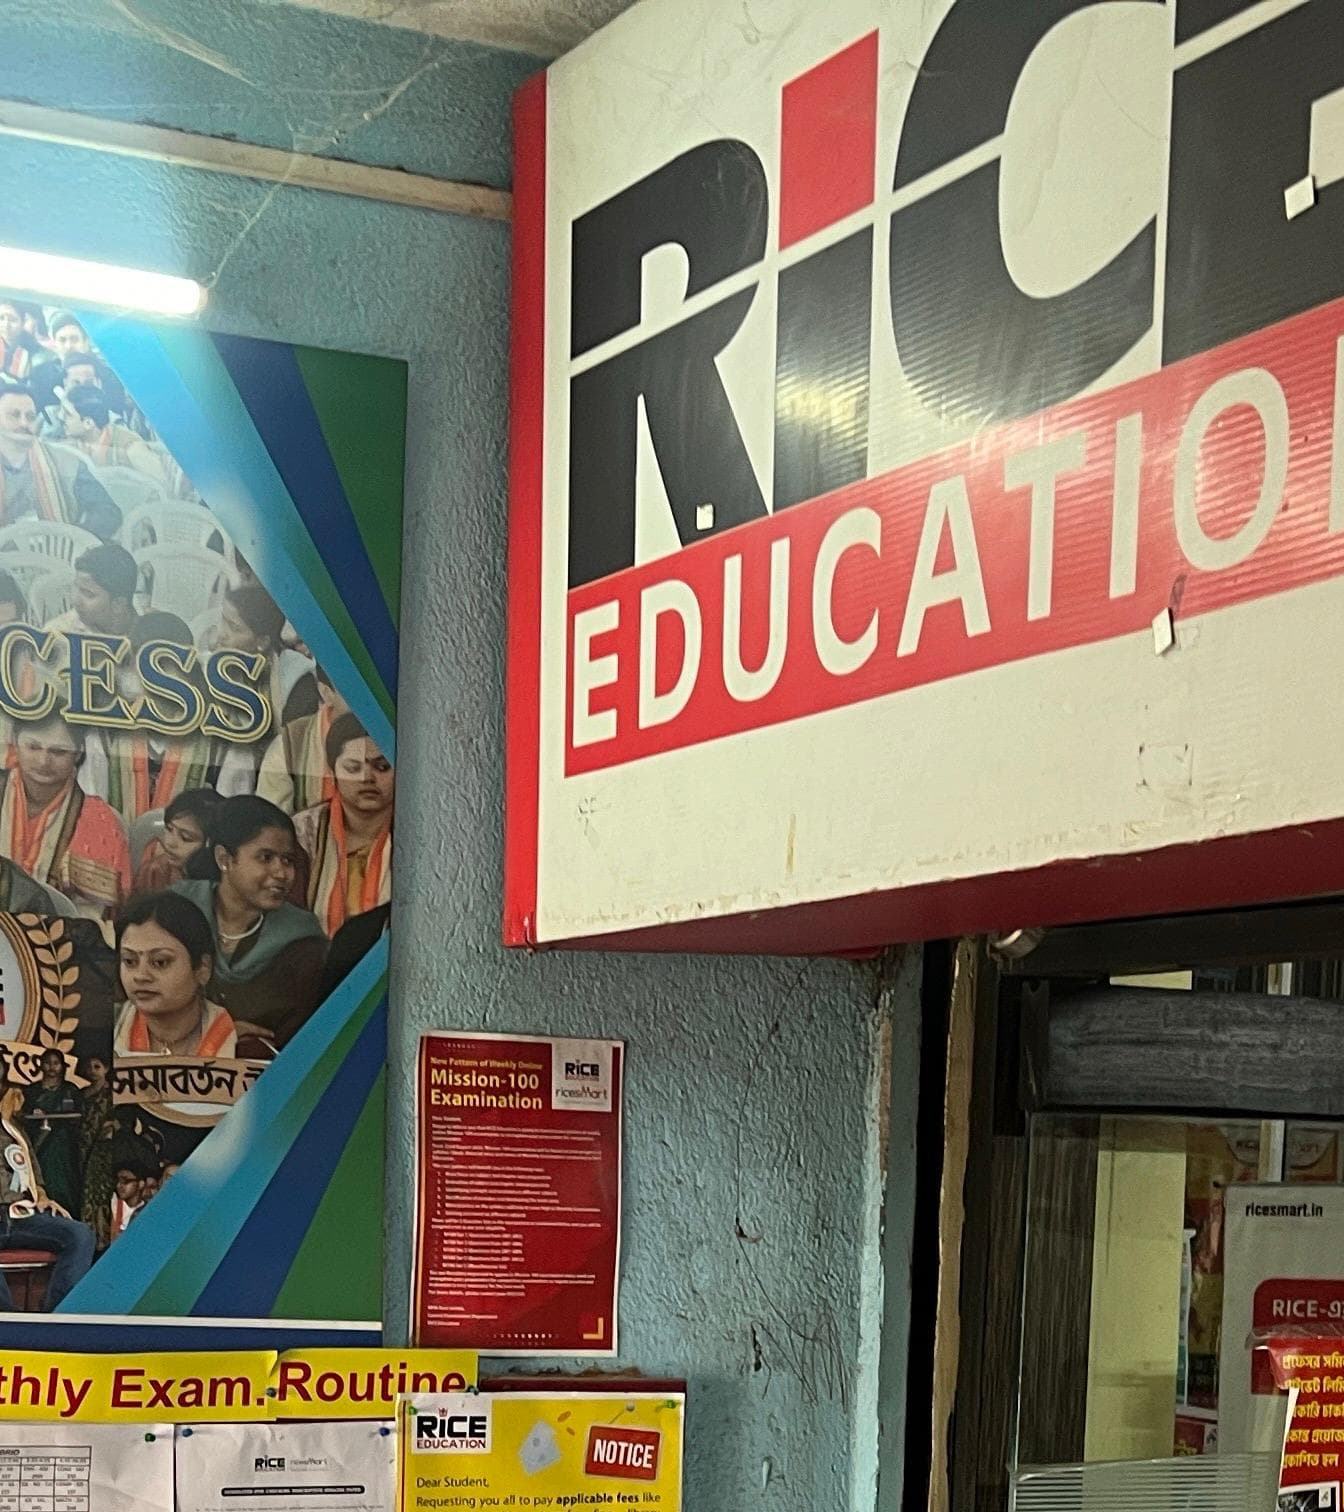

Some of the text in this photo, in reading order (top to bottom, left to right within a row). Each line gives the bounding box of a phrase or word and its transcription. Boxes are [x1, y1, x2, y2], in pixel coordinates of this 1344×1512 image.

[431, 1068, 539, 1089] Mission-100
[431, 1089, 543, 1109] Examination
[1246, 1202, 1323, 1218] ricesmart.in
[111, 1368, 265, 1408] Exam.
[278, 1361, 466, 1402] Routine
[417, 1438, 486, 1448] EDUCATION
[593, 1439, 654, 1468] NOTICE
[417, 1476, 489, 1488] Dear Student,
[416, 1493, 660, 1508] Requesting you all to pay applicable fees like
